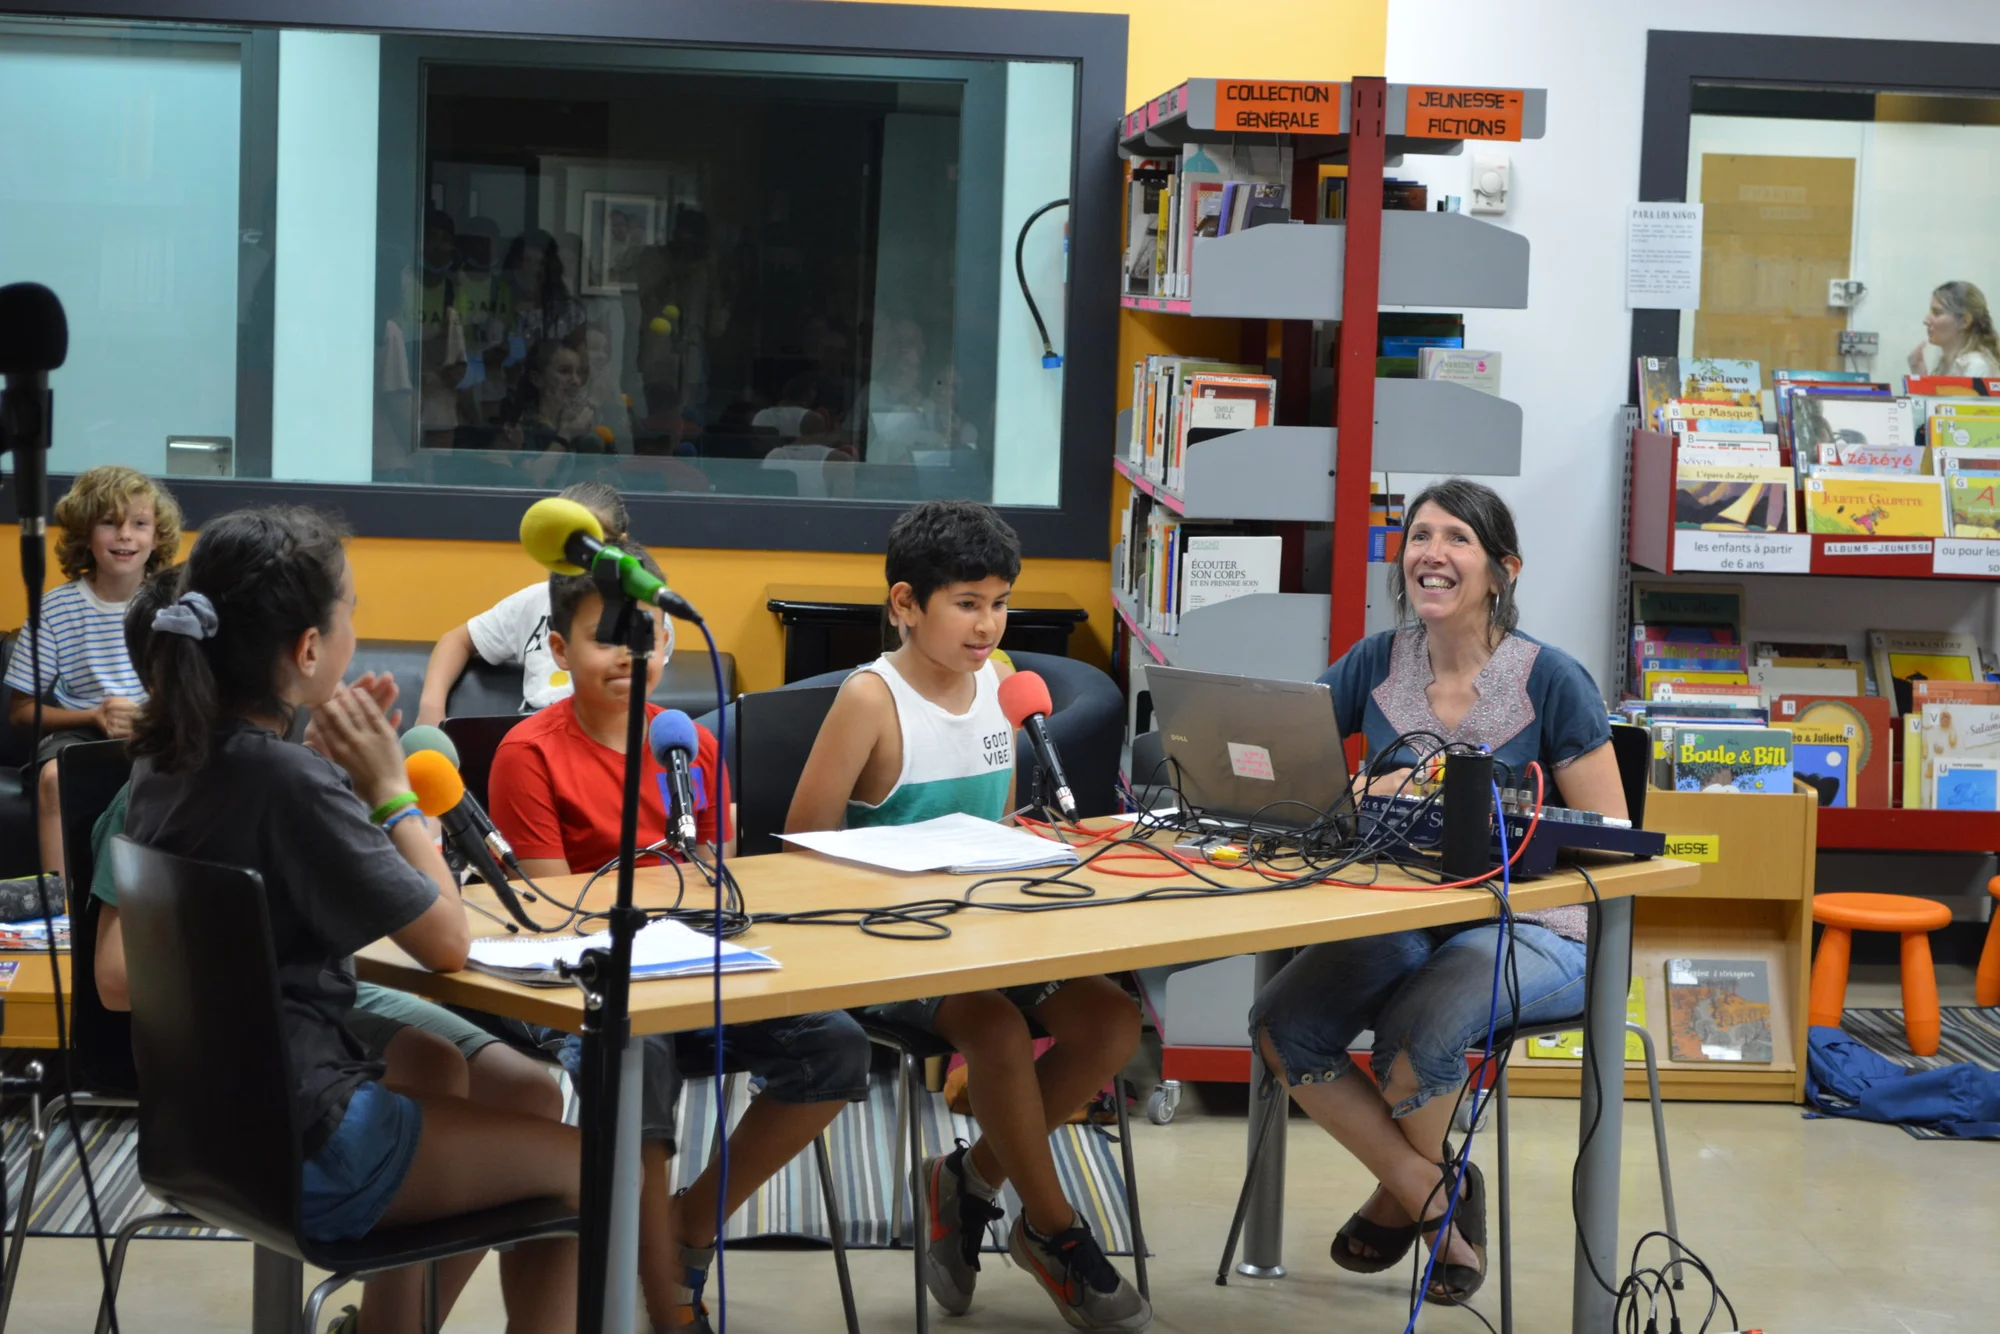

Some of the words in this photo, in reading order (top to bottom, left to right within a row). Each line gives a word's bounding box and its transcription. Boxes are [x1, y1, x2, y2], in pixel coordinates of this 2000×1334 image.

[1226, 84, 1330, 103] COLLECTION
[1418, 91, 1505, 109] JEUNESSE
[1427, 118, 1506, 136] FICTIONS
[1632, 209, 1654, 219] PARA
[1656, 210, 1670, 220] LOS
[1672, 210, 1697, 220] NIÑOS
[1690, 373, 1748, 384] L'esclave
[1672, 408, 1679, 416] B
[1692, 407, 1705, 416] Le
[1709, 408, 1753, 420] Masque
[1688, 434, 1695, 443] B
[1827, 448, 1834, 457] D
[1812, 482, 1820, 490] D
[1694, 542, 1709, 552] les
[1712, 542, 1751, 553] enfants
[1754, 544, 1760, 553] à
[1763, 545, 1793, 556] partir
[1827, 544, 1868, 553] ALBUMS
[1878, 544, 1930, 552] JEUNESSE
[1942, 547, 1955, 556] ou
[1958, 547, 1982, 560] pour
[1986, 546, 2000, 556] les
[1191, 559, 1237, 569] ÉCOUTER
[1721, 559, 1734, 568] de
[1737, 559, 1743, 568] 6
[1746, 561, 1765, 569] ans
[1191, 570, 1211, 579] SON
[1214, 570, 1246, 579] CORPS
[1787, 703, 1794, 712] R
[1930, 714, 1938, 722] V
[1913, 721, 1920, 730] V
[1846, 727, 1854, 736] R
[1813, 733, 1849, 743] Juliette
[1680, 745, 1737, 764] Boule
[1739, 750, 1752, 764] &
[1753, 746, 1787, 766] Bill
[1940, 764, 1947, 774] U
